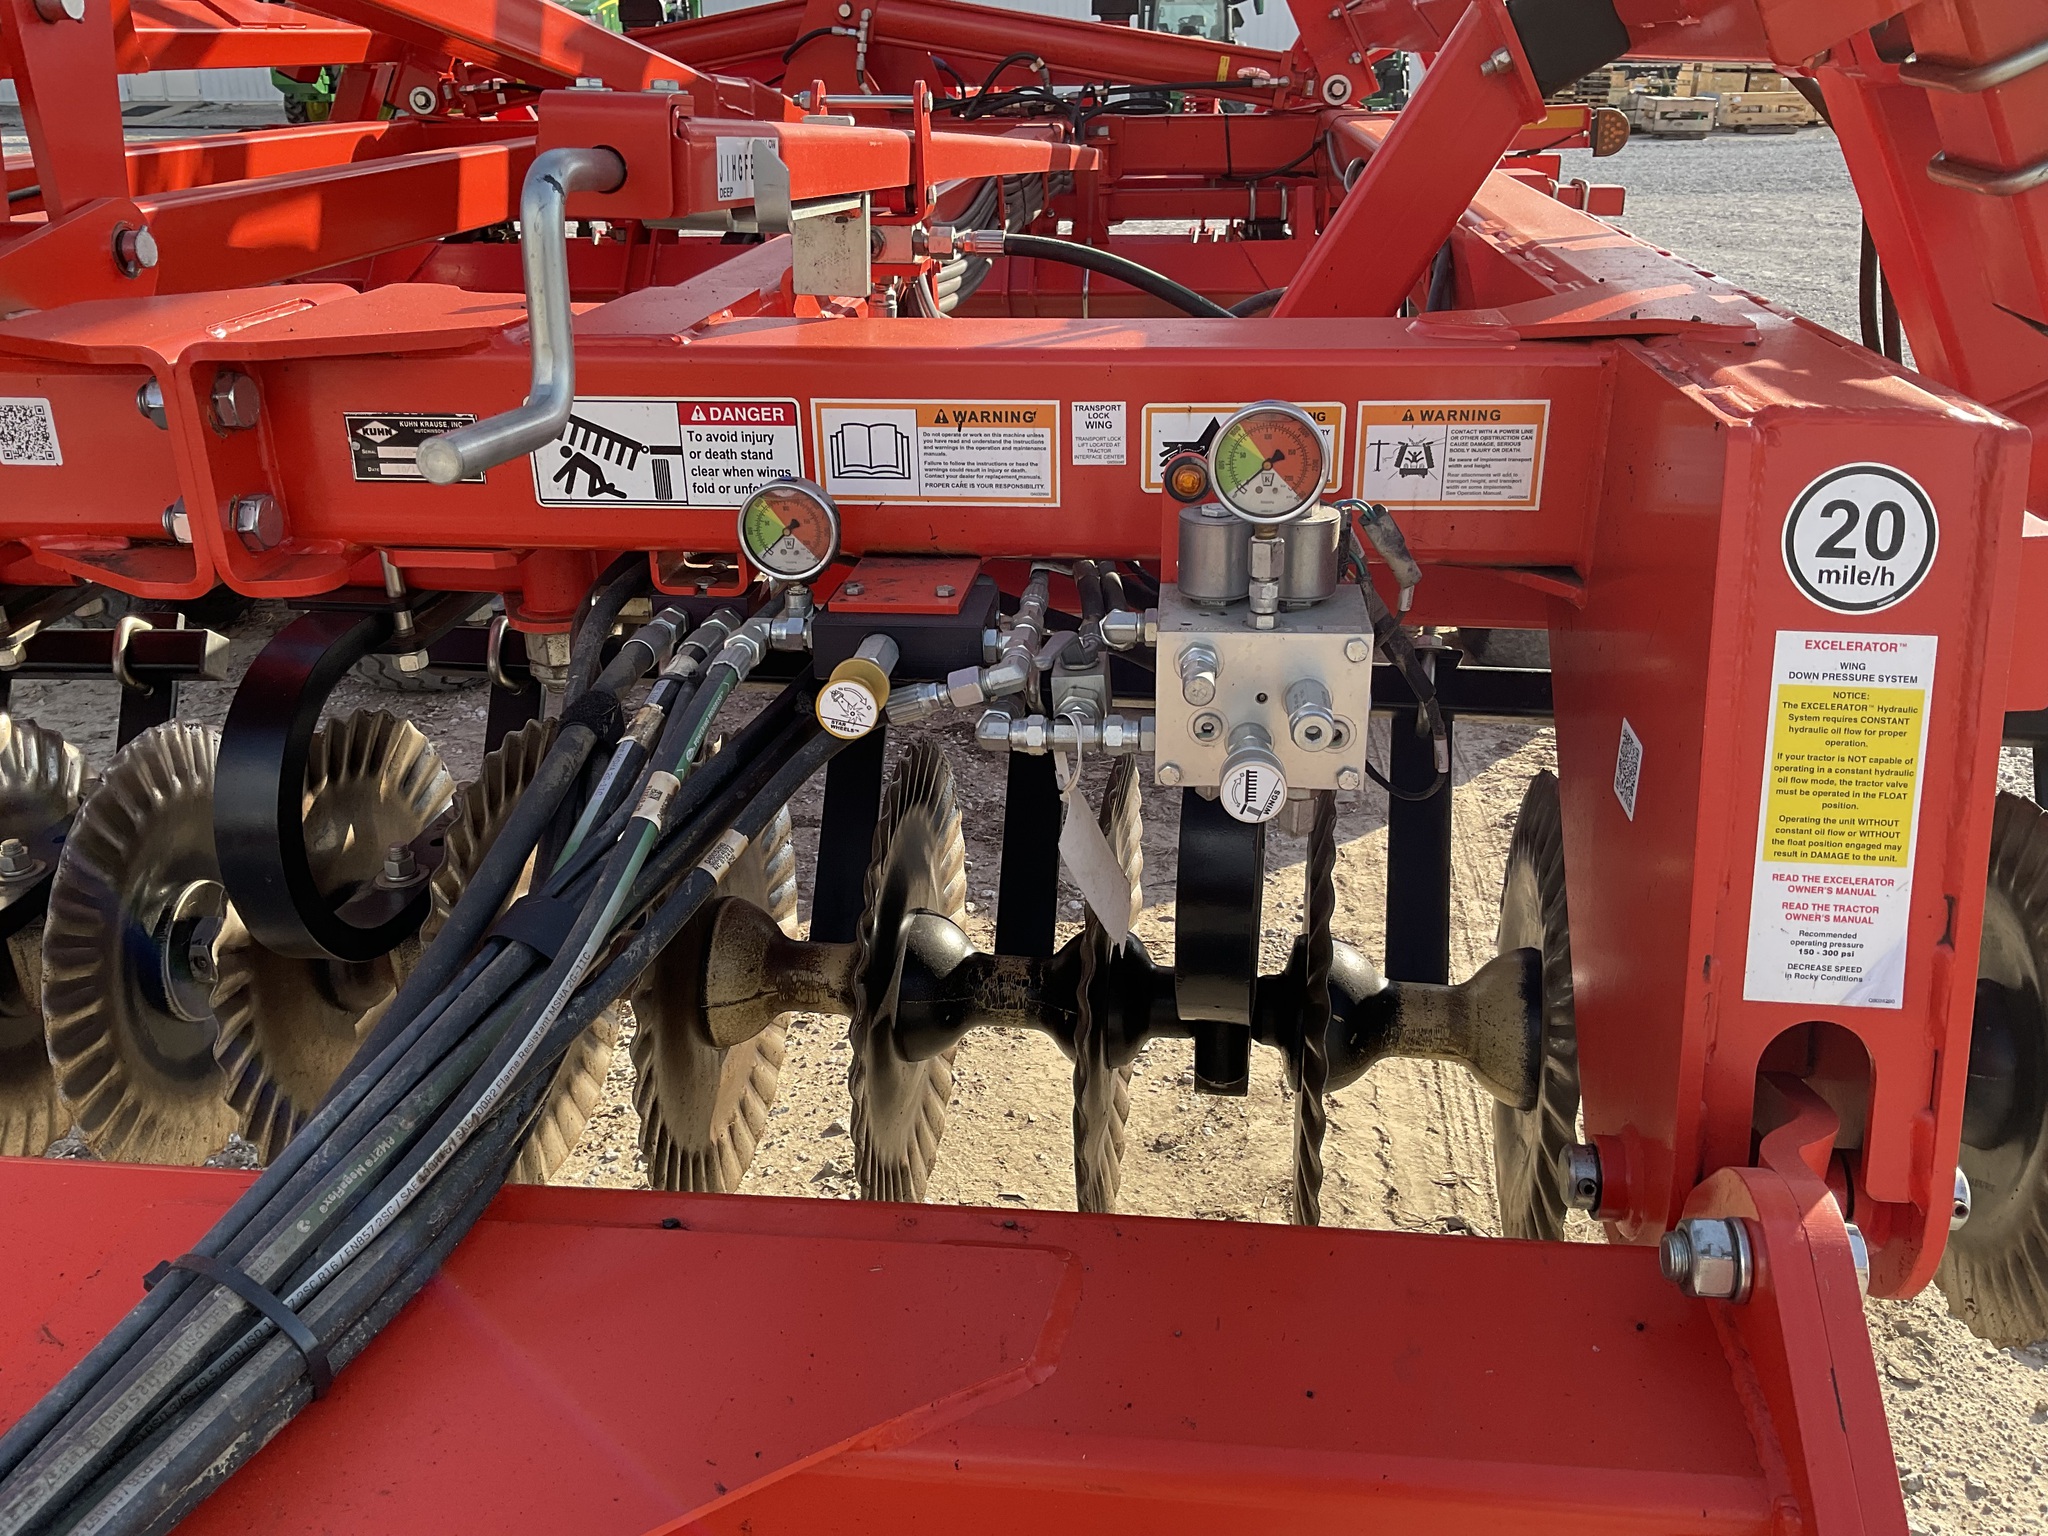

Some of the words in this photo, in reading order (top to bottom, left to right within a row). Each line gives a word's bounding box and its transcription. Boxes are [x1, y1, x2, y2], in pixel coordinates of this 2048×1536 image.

[720, 187, 733, 198] DEEP
[710, 407, 784, 421] DANGER
[953, 411, 1034, 423] WARNING
[1420, 410, 1501, 421] WARNING
[1085, 421, 1112, 429] WING
[362, 428, 392, 436] KUHN
[687, 431, 702, 442] To
[706, 431, 737, 442] avoid
[741, 431, 774, 445] injury
[690, 451, 701, 459] or
[705, 449, 737, 460] death
[741, 449, 773, 460] stand
[691, 466, 719, 476] clear
[723, 466, 753, 477] when
[757, 467, 791, 477] wings
[692, 482, 715, 493] fold
[1815, 499, 1906, 561] 20
[1818, 565, 1894, 586] mile/h
[1840, 662, 1866, 671] WING
[1788, 672, 1819, 680] DOWN
[1822, 673, 1875, 682] PRESSURE
[1878, 675, 1918, 683] SYSTEM
[1833, 691, 1869, 700] NOTICE:
[1877, 705, 1918, 714] Hydraulic
[1788, 714, 1820, 723] System
[1823, 716, 1858, 724] requires
[1860, 717, 1909, 725] CONSTANT
[1788, 726, 1828, 736] hydraulic
[1825, 740, 1868, 748] operation.
[1774, 766, 1814, 774] operating
[1874, 768, 1914, 777] hydraulic
[1811, 778, 1837, 786] mode,
[1812, 790, 1850, 798] operated
[1263, 790, 1280, 814] WINGS
[1822, 802, 1859, 810] position.
[1779, 815, 1821, 825] Operating
[1858, 819, 1899, 827] WITHOUT
[1775, 827, 1812, 835] constant
[1859, 830, 1900, 838] WITHOUT
[1808, 840, 1843, 848] position
[1810, 851, 1850, 860] DAMAGE
[1772, 873, 1799, 882] READ
[1823, 876, 1895, 887] EXCELERATOR
[1788, 885, 1833, 895] OWNER'S
[1836, 887, 1876, 896] MANUAL
[1782, 902, 1809, 910] READ
[1812, 903, 1830, 911] THE
[1833, 904, 1880, 914] TRACTOR
[1785, 913, 1830, 922] OWNER'S
[1833, 915, 1874, 924] MANUAL
[1799, 930, 1857, 939] Recommended
[1790, 939, 1828, 948] operating
[1787, 963, 1832, 972] DECREASE
[1835, 965, 1862, 973] SPEED
[1794, 973, 1818, 981] Rocky
[1820, 974, 1863, 982] Conditions
[317, 1262, 339, 1280] R16
[344, 1225, 374, 1257] EN857
[375, 1204, 396, 1228] 2SC
[400, 1181, 418, 1202] SAE
[497, 1060, 521, 1090] Flame
[518, 1014, 551, 1062] Resistant
[549, 988, 569, 1016] MSHA
[566, 952, 591, 989] 2G-11C
